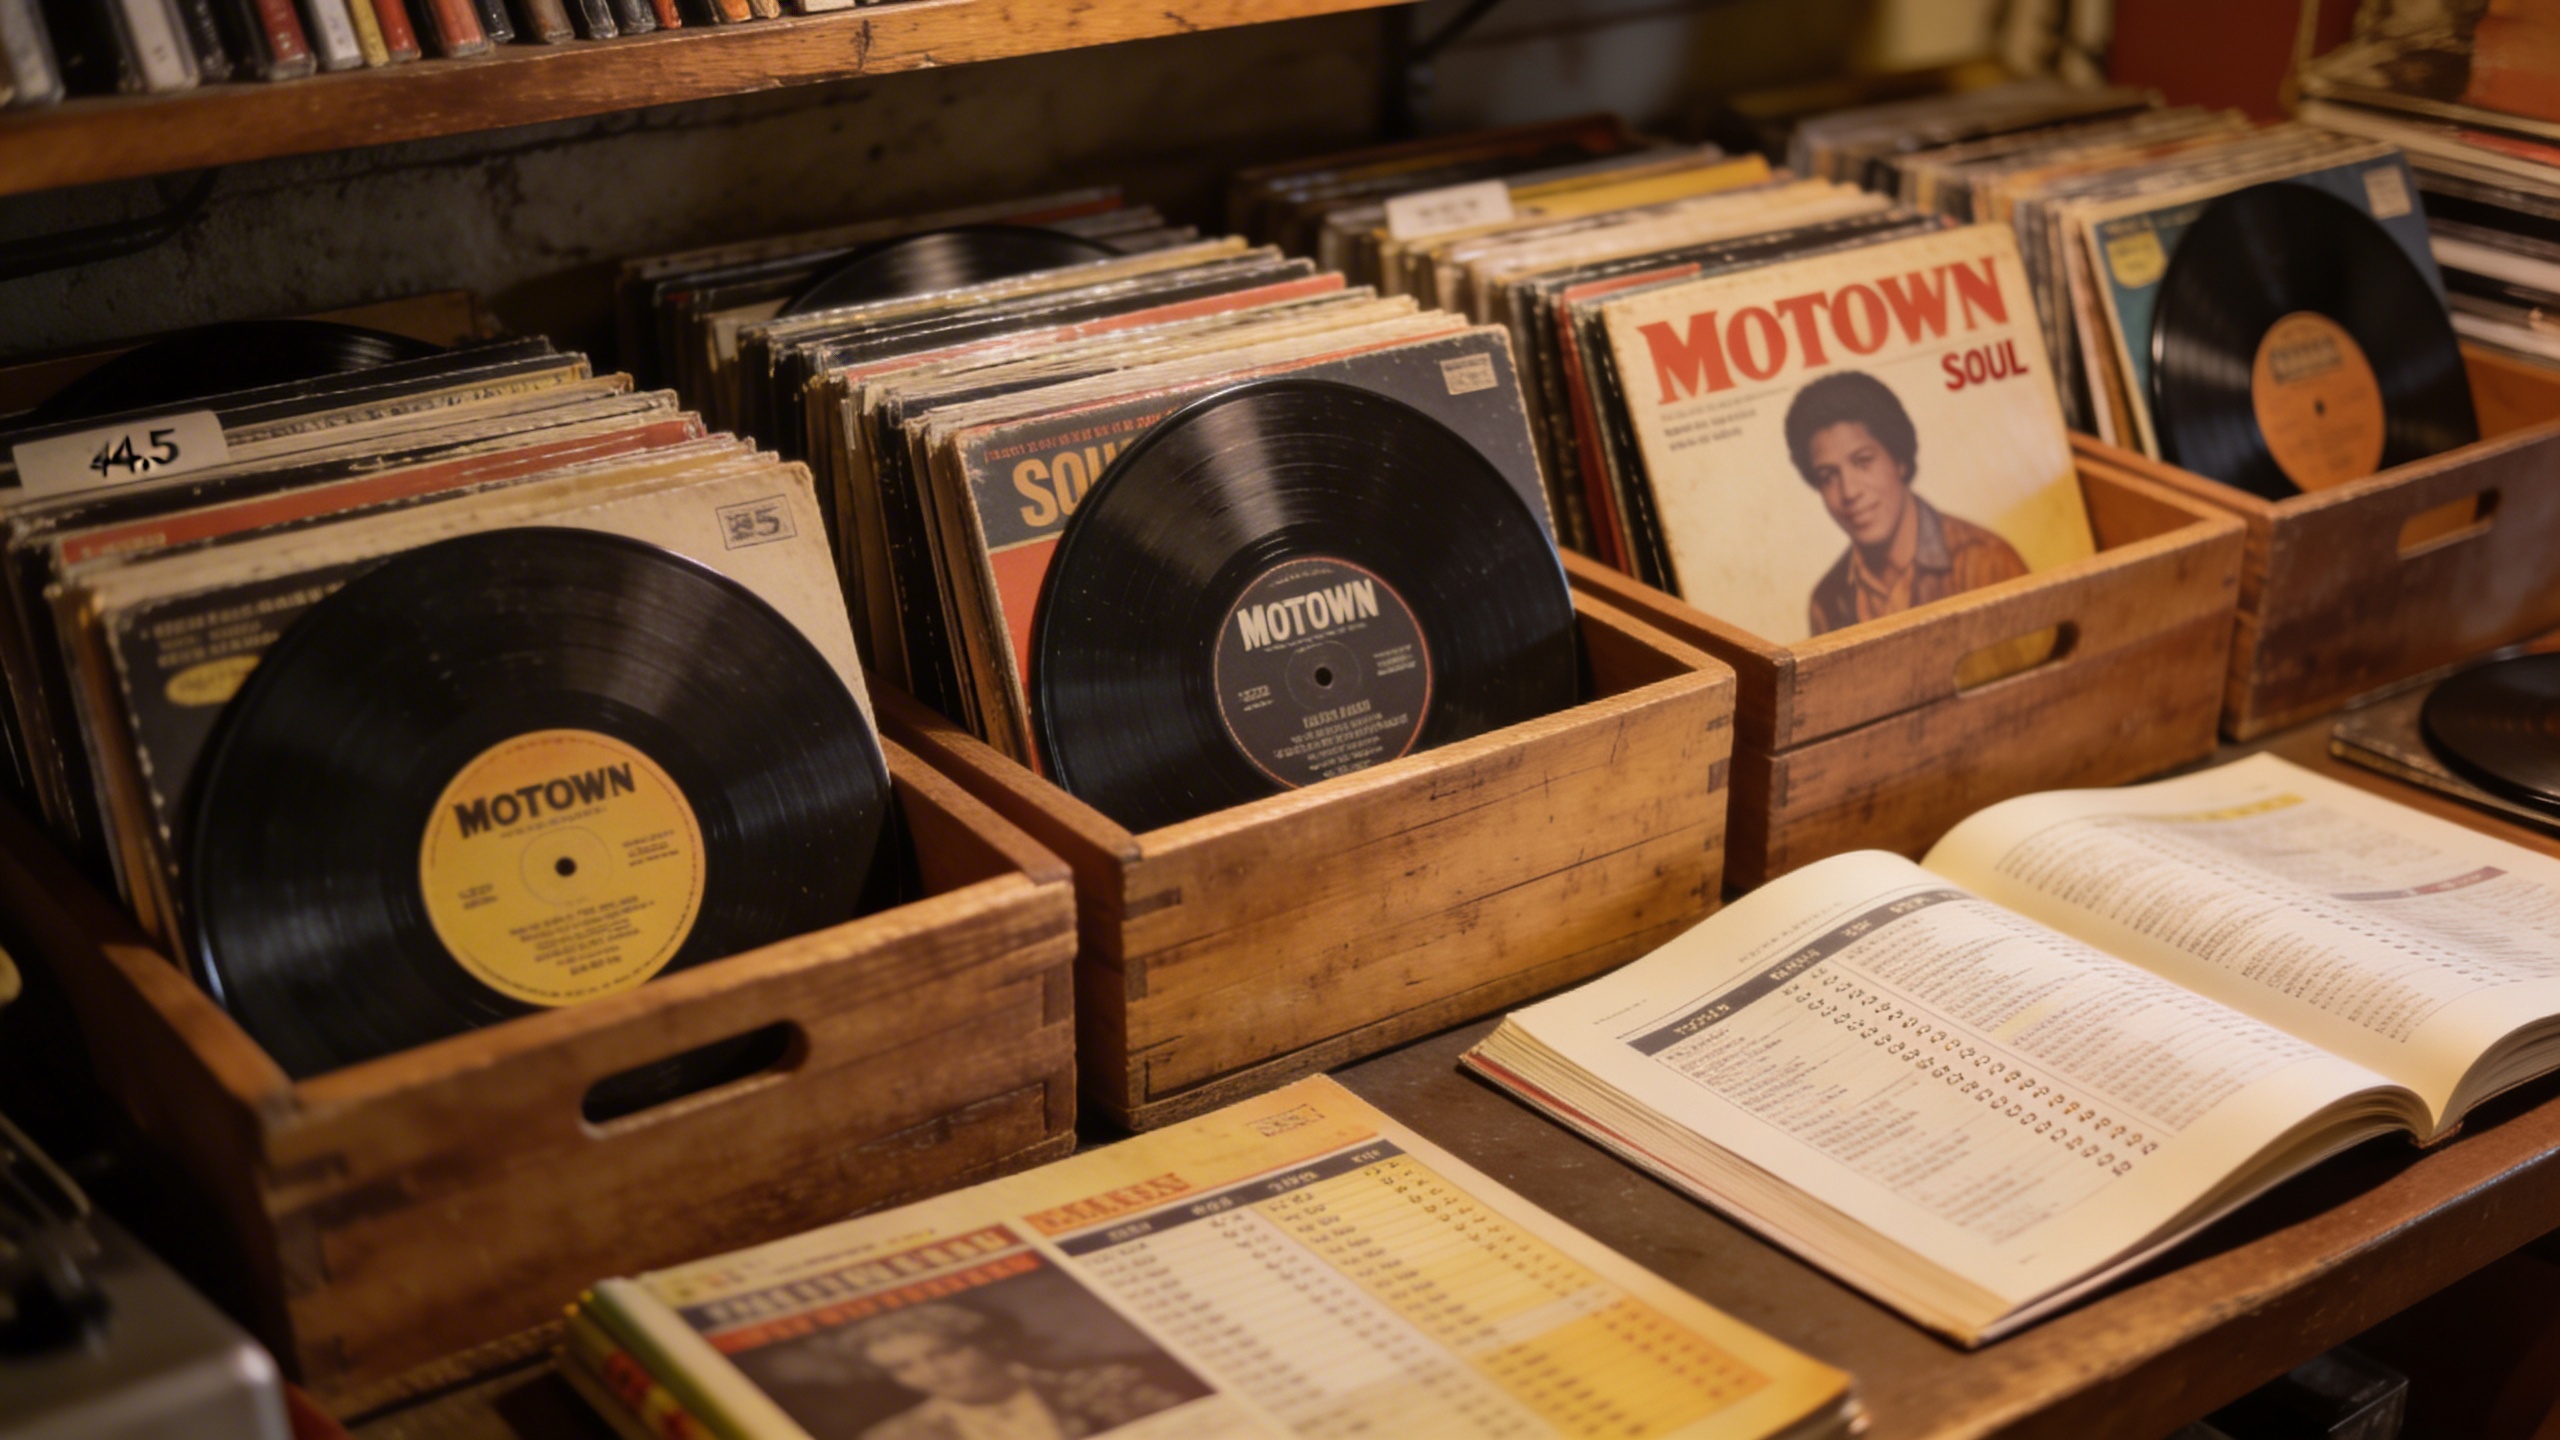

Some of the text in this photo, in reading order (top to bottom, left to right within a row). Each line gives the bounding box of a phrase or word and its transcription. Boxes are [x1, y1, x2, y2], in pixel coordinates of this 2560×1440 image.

[1636, 256, 2010, 405] MOTOWN
[1941, 338, 2029, 392] SOUL
[1012, 437, 1135, 528] SO
[1236, 578, 1380, 652] MOTOWN
[452, 762, 637, 840] MOTOWN
